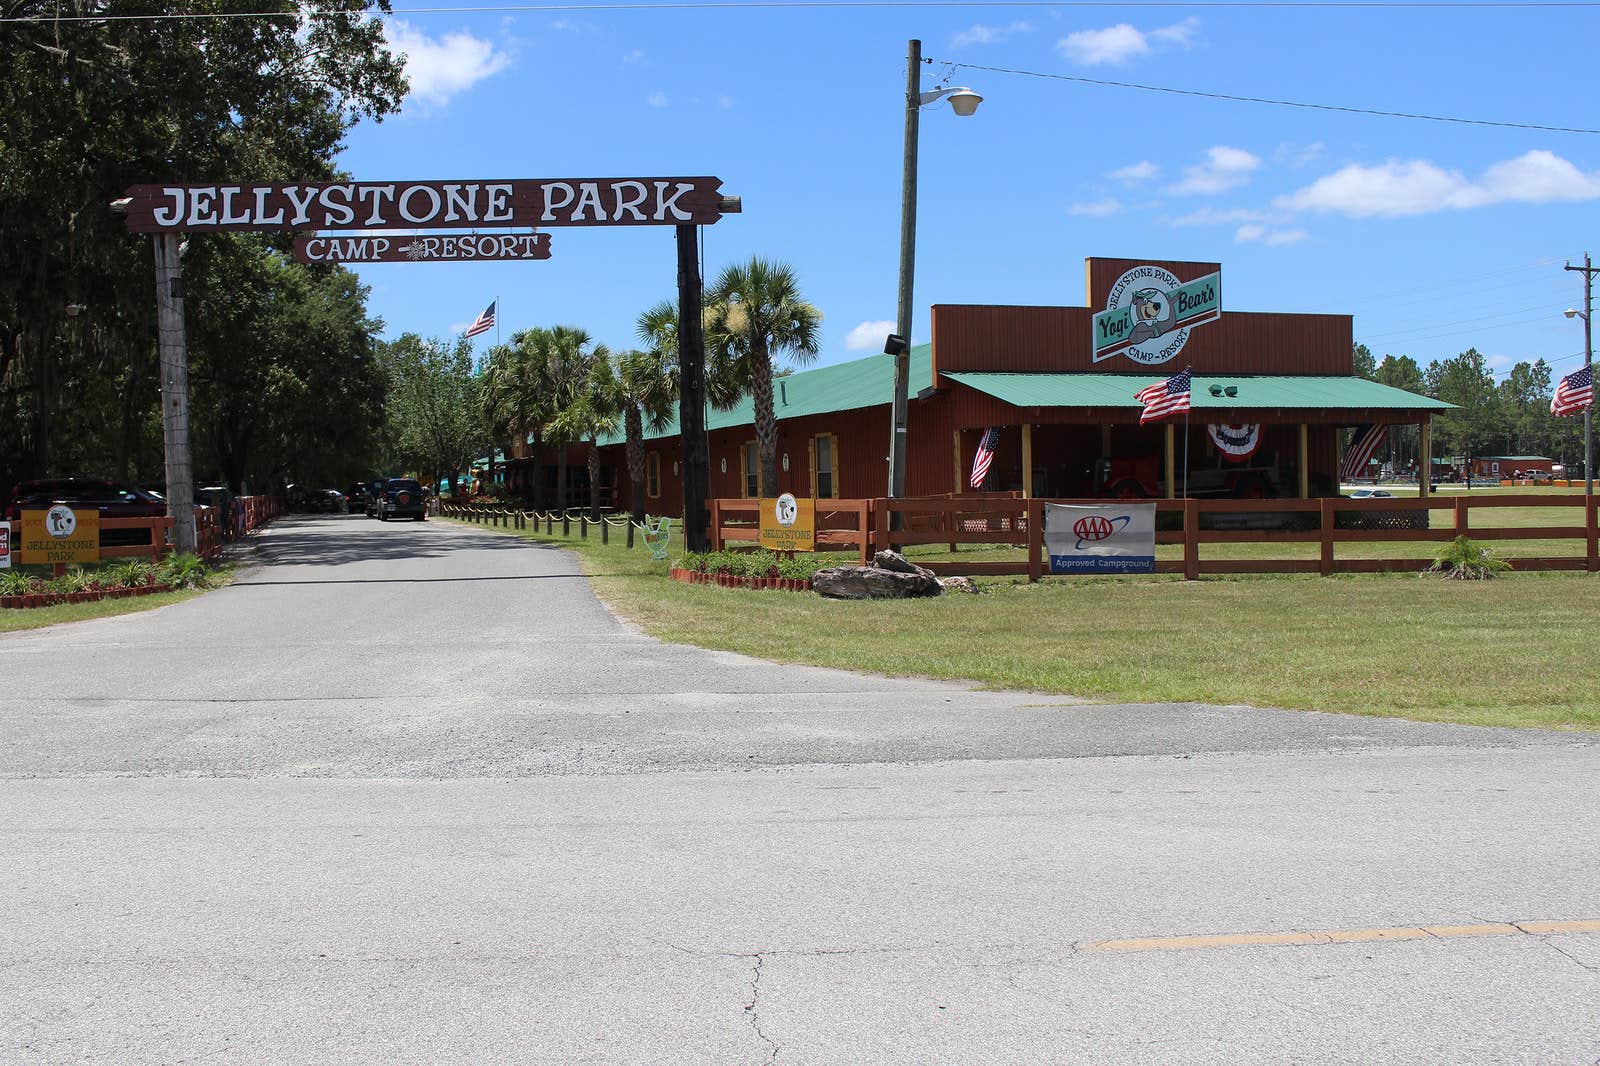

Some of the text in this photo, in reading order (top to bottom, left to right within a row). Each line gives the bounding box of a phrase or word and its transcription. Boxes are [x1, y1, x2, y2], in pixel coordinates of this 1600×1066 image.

[153, 181, 695, 227] JELLYSTONE PARK
[305, 238, 391, 260] CAMP
[1109, 268, 1178, 310] JELLYSTONE PARK
[1099, 284, 1215, 338] Yogi Bear's
[763, 529, 812, 540] JELLYSTONE
[1078, 517, 1110, 540] AAA
[27, 540, 96, 551] JELLYSTONE
[47, 551, 75, 561] PARK
[1056, 560, 1150, 568] Approved Campground
